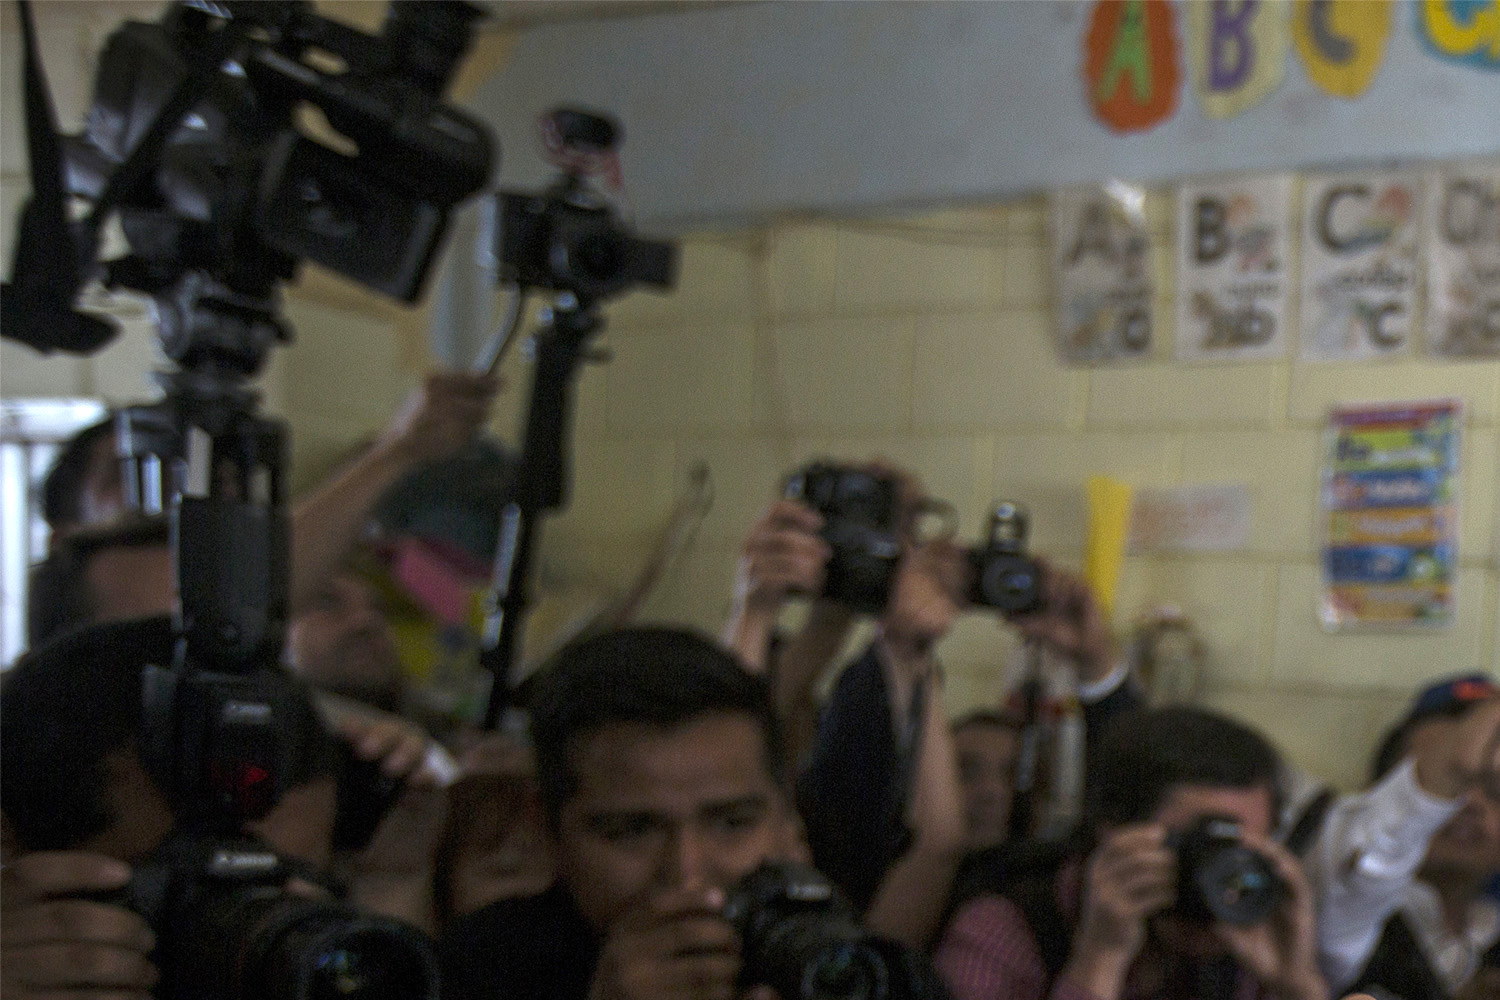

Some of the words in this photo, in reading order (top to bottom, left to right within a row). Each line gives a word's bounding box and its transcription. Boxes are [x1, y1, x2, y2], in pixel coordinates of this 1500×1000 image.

[1102, 0, 1152, 107] A
[1208, 0, 1258, 92] B
[1194, 196, 1232, 266] B
[1315, 183, 1379, 254] C
[1369, 303, 1405, 350] c
